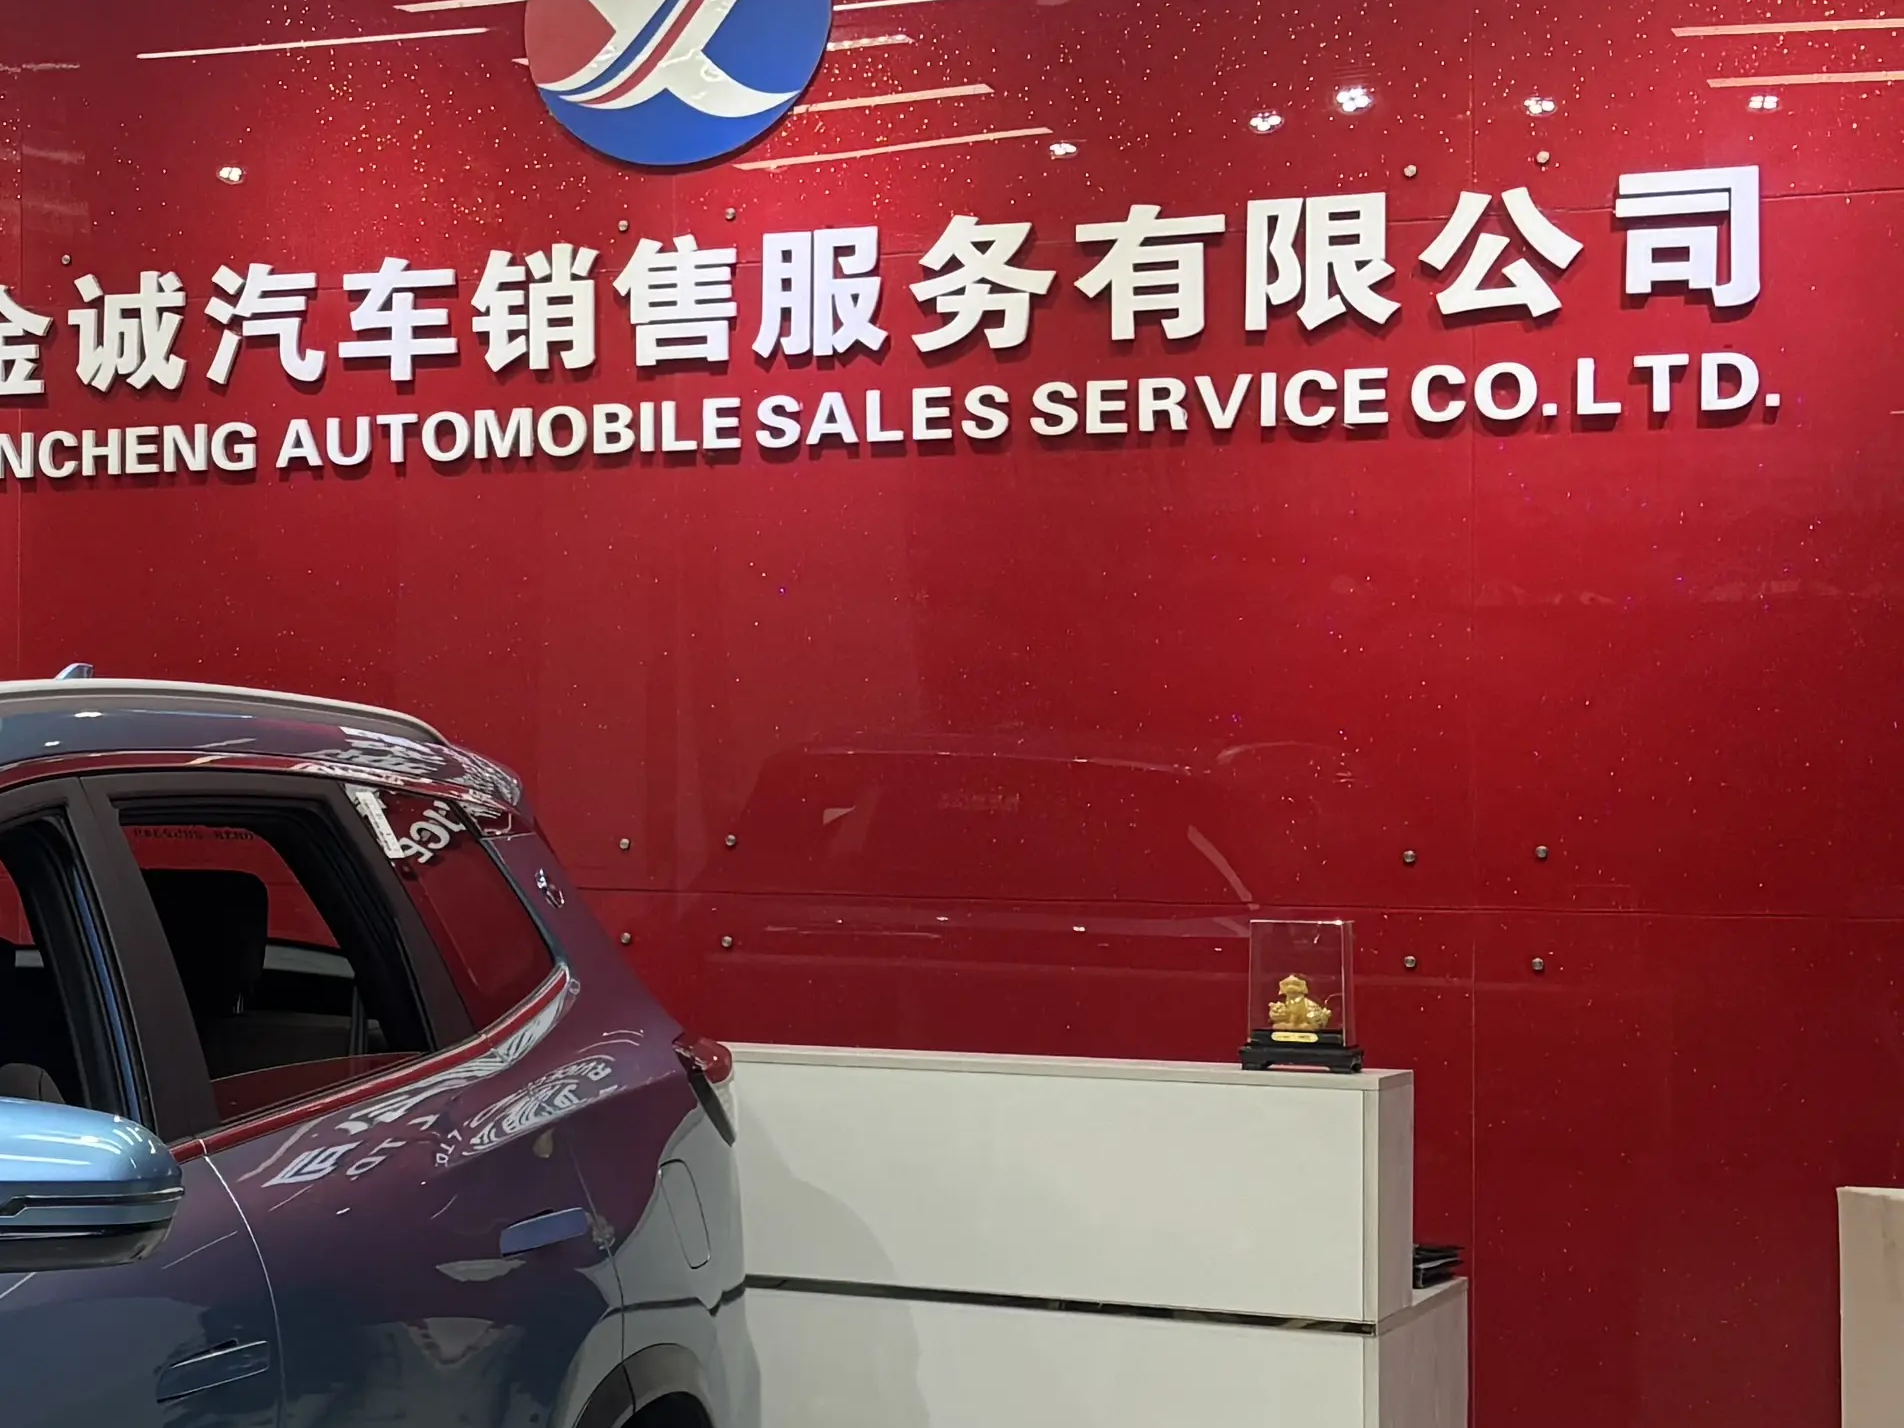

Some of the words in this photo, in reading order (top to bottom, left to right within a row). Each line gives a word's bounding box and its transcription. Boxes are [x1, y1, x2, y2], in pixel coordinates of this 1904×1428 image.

[276, 395, 743, 470] AUTOMOBILE
[756, 386, 1010, 448] SALES
[1030, 365, 1390, 435] SERVICE
